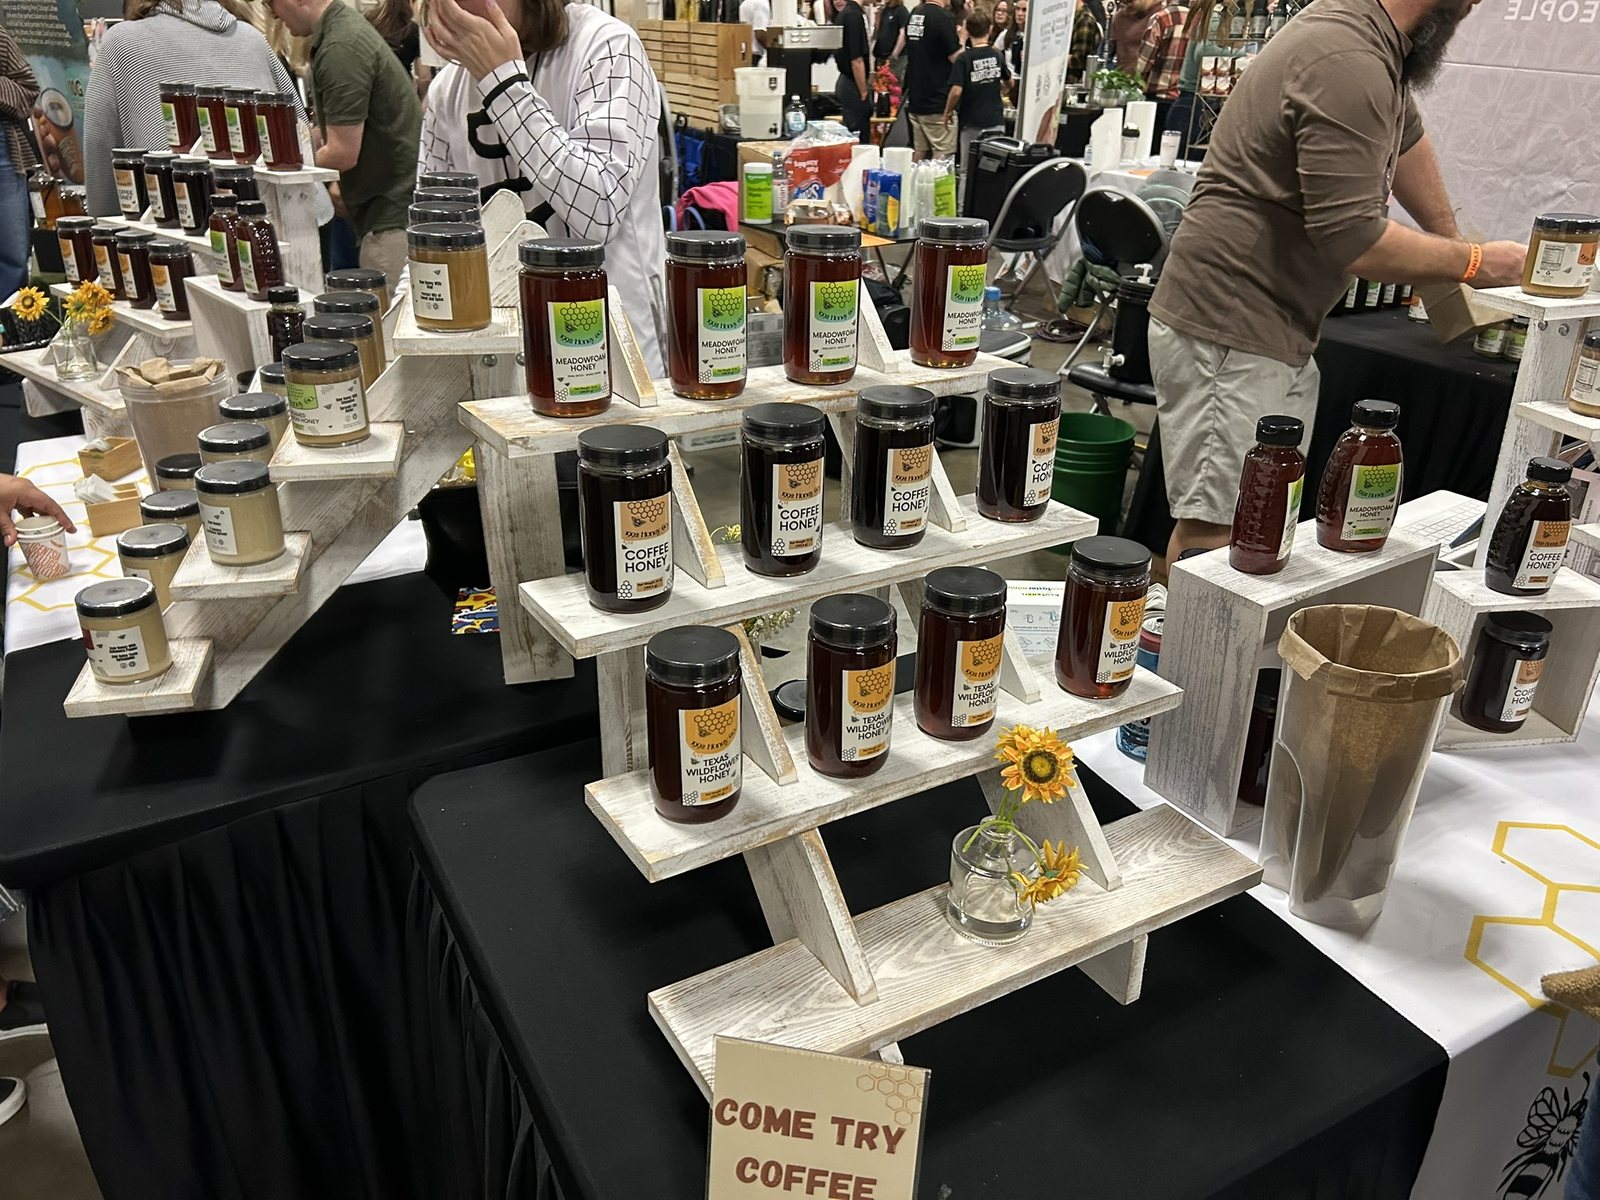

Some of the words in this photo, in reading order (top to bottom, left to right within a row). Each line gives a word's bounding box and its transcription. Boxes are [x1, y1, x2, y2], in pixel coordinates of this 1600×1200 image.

[824, 337, 847, 345] HONEY
[714, 347, 737, 355] HONEY
[570, 363, 597, 372] HONEY
[893, 486, 929, 502] COFFEE
[780, 504, 820, 520] COFFEE
[892, 498, 927, 512] HONEY
[1349, 504, 1394, 513] MEADOWFOAM
[779, 516, 818, 531] HONEY
[624, 541, 669, 560] COFFEE
[1529, 552, 1562, 561] COFFEE
[625, 555, 667, 573] HONEY
[1526, 561, 1558, 569] HONEY
[973, 681, 994, 692] TEXAS
[968, 697, 993, 708] HONEY
[862, 711, 885, 724] TEXAS
[858, 727, 885, 740] HONEY
[686, 754, 739, 776] WILDFLOWER
[703, 752, 729, 767] TEXAS
[699, 768, 731, 783] HONEY
[714, 1098, 816, 1140] COME
[830, 1115, 907, 1155] TRY
[735, 1156, 878, 1200] COFFEE
